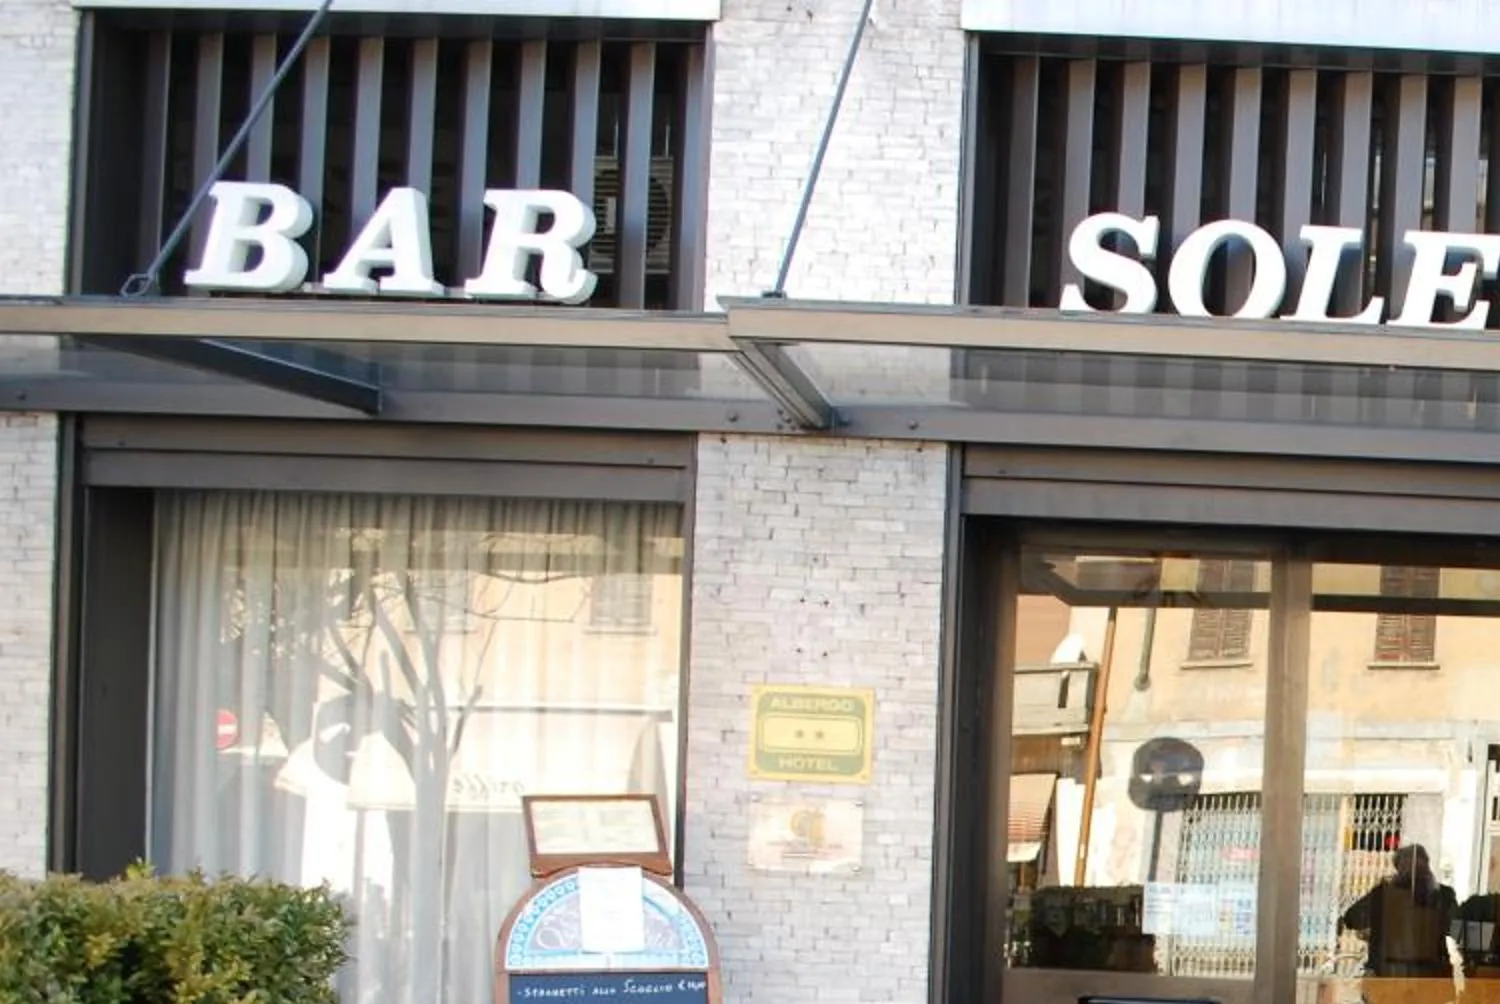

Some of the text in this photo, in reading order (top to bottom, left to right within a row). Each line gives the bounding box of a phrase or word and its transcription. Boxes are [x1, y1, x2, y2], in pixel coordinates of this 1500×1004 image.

[184, 180, 598, 305] BAR
[769, 696, 855, 712] ALBERGO
[778, 755, 840, 771] HOTEL
